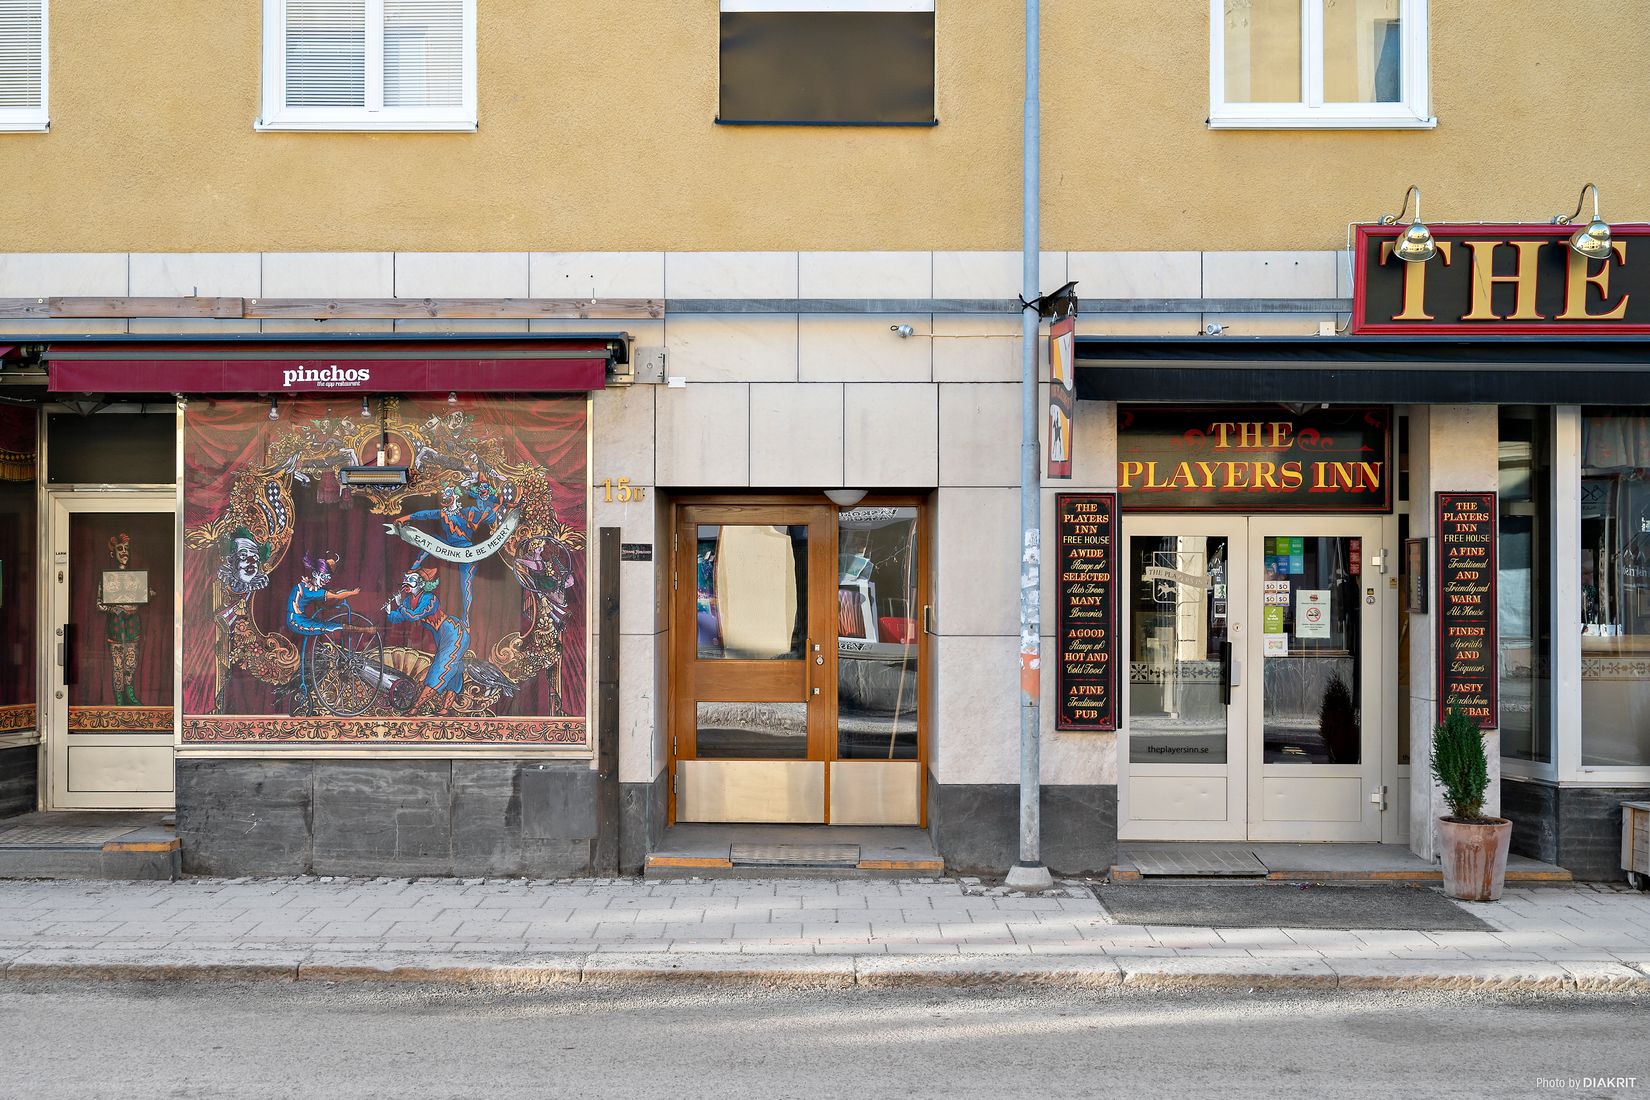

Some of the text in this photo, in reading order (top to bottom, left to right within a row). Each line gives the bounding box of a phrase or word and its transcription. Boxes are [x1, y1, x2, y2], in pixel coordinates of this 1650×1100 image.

[1380, 240, 1629, 320] THE
[283, 365, 370, 387] pinchos
[1209, 421, 1295, 450] THE
[1118, 460, 1384, 491] PLAYERS INN
[1075, 503, 1098, 512] THE
[1456, 502, 1478, 510] THE
[1063, 514, 1109, 523] PLAYERS
[1443, 512, 1489, 521] PLAYERS
[1074, 525, 1098, 534] INN
[1456, 523, 1478, 532] INN
[435, 545, 461, 558] DRINK
[465, 549, 474, 558] &
[476, 548, 487, 556] BE
[487, 524, 510, 550] MERRY
[1063, 535, 1110, 544] FREE HOUSE
[1444, 534, 1490, 542] FREE HOUSE
[1069, 548, 1104, 558] A WIDE
[1449, 547, 1485, 556] A FINE
[1070, 559, 1094, 572] Range
[1448, 557, 1489, 569] Traditional
[1063, 572, 1110, 581] SELECTED
[1456, 571, 1479, 580] AND
[1066, 583, 1105, 594] Ales From
[1443, 581, 1490, 595] Friendly and
[1070, 596, 1102, 606] MANY
[1450, 594, 1481, 604] WARM
[1069, 607, 1103, 618] Breweries
[1447, 605, 1484, 616] Ale House
[1068, 629, 1105, 638] A GOOD
[1448, 627, 1486, 636] FINEST
[1069, 640, 1093, 652] Range
[1064, 652, 1108, 662] HOT AND
[1456, 650, 1480, 660] AND
[1066, 663, 1106, 674] Cold Food
[1450, 661, 1485, 674] Liqueurs
[1069, 686, 1105, 695] A FINE
[1450, 683, 1484, 692] TASTY
[1068, 696, 1107, 708] Traditional
[1472, 694, 1489, 705] from
[1074, 710, 1098, 719] PUB
[1469, 707, 1490, 716] BAR
[1147, 745, 1209, 755] theplayersinn.se
